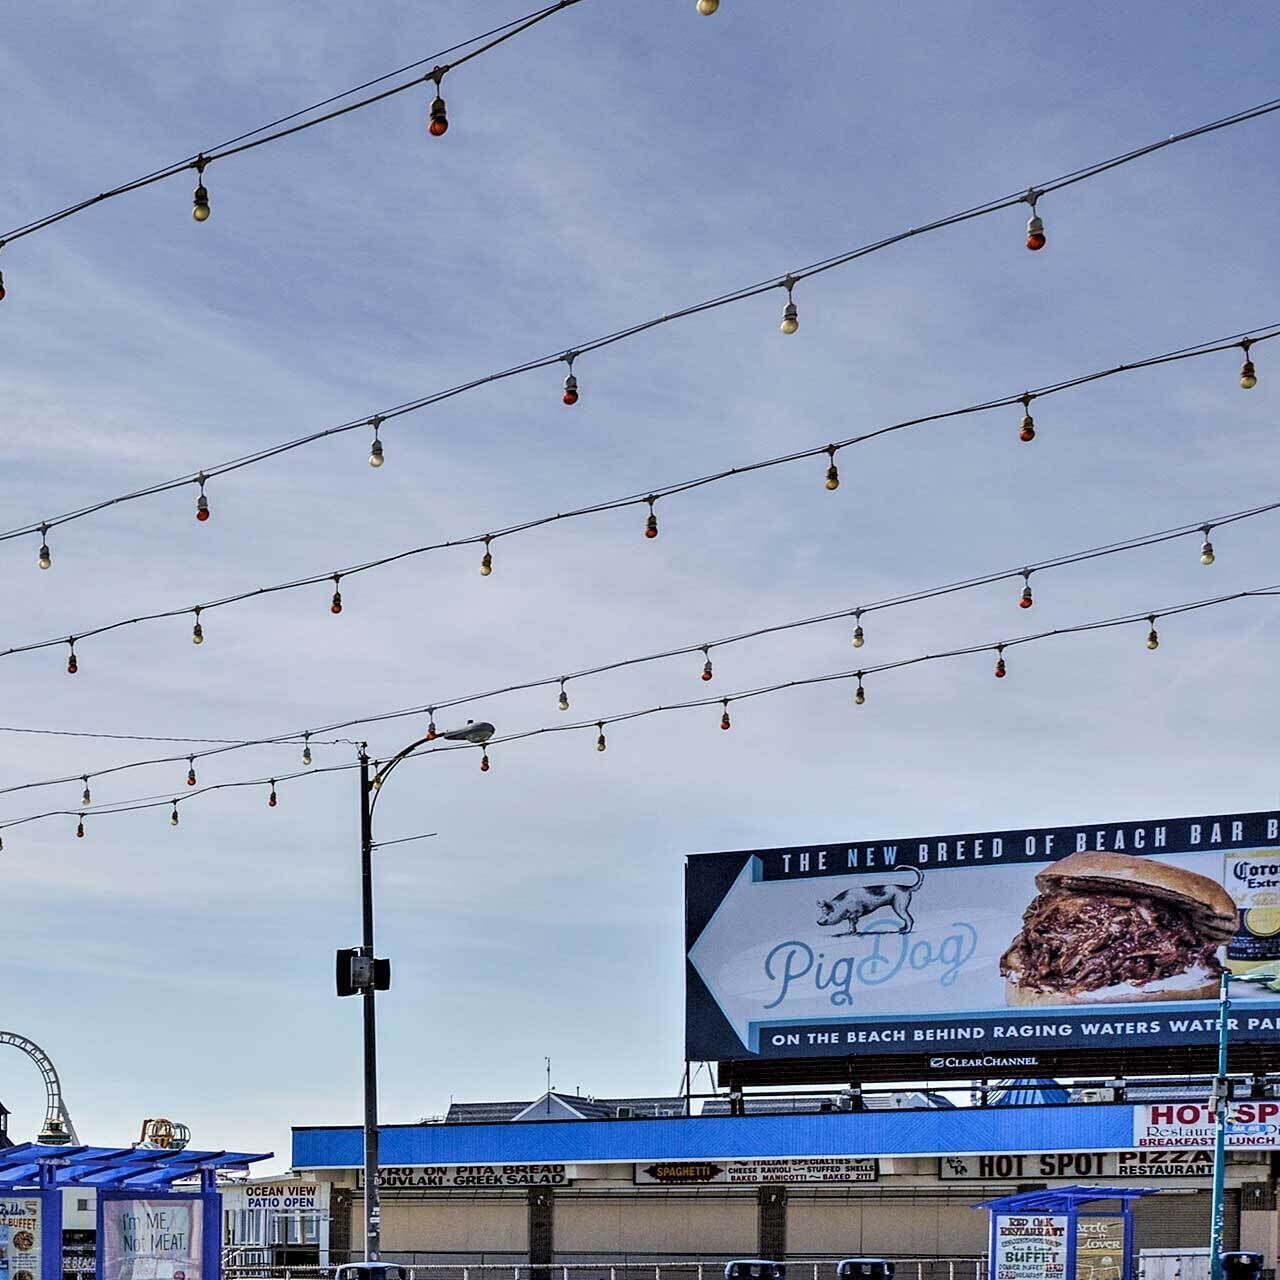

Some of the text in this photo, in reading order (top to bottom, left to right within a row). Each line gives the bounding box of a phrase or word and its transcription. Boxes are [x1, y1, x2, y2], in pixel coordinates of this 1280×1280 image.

[782, 851, 827, 873] THE
[847, 846, 897, 868] NEW
[918, 838, 1003, 863] BREED
[1025, 834, 1054, 855] OF
[1076, 827, 1166, 851] BEACH
[1190, 821, 1243, 844] BAR
[1233, 861, 1280, 881] Coro
[772, 1034, 800, 1046] ON
[807, 1032, 839, 1045] THE
[847, 1030, 906, 1043] BEACH
[914, 1027, 985, 1041] BEHIND
[993, 1024, 1072, 1038] RAGING
[1081, 1021, 1161, 1035] WATERS
[1169, 1019, 1239, 1033] WATER
[1146, 1126, 1216, 1137] Restaura
[1139, 1137, 1275, 1146] BREAKFAST LUNCH
[1119, 1150, 1213, 1164] PIZZA
[362, 1164, 565, 1176] YRO ON PITA BREAD
[761, 1166, 791, 1174] RAVIOLI
[807, 1165, 841, 1173] STUFFED
[979, 1152, 1107, 1176] HOT SPOT
[1119, 1164, 1213, 1176] RESTAURANT
[657, 1166, 711, 1177] SPAGHETTI
[362, 1174, 565, 1186] OUVLAKI GREEK SALAD
[246, 1186, 316, 1196] OCEAN VIEW
[248, 1197, 314, 1207] PATIO OPEN
[8, 1218, 37, 1230] BUFFET
[122, 1211, 170, 1232] I'm ME,
[1008, 1217, 1054, 1226] RED OAK
[1000, 1226, 1065, 1236] RESTAURANT
[151, 1232, 186, 1252] MEAT.
[1005, 1252, 1059, 1262] BUFFET
